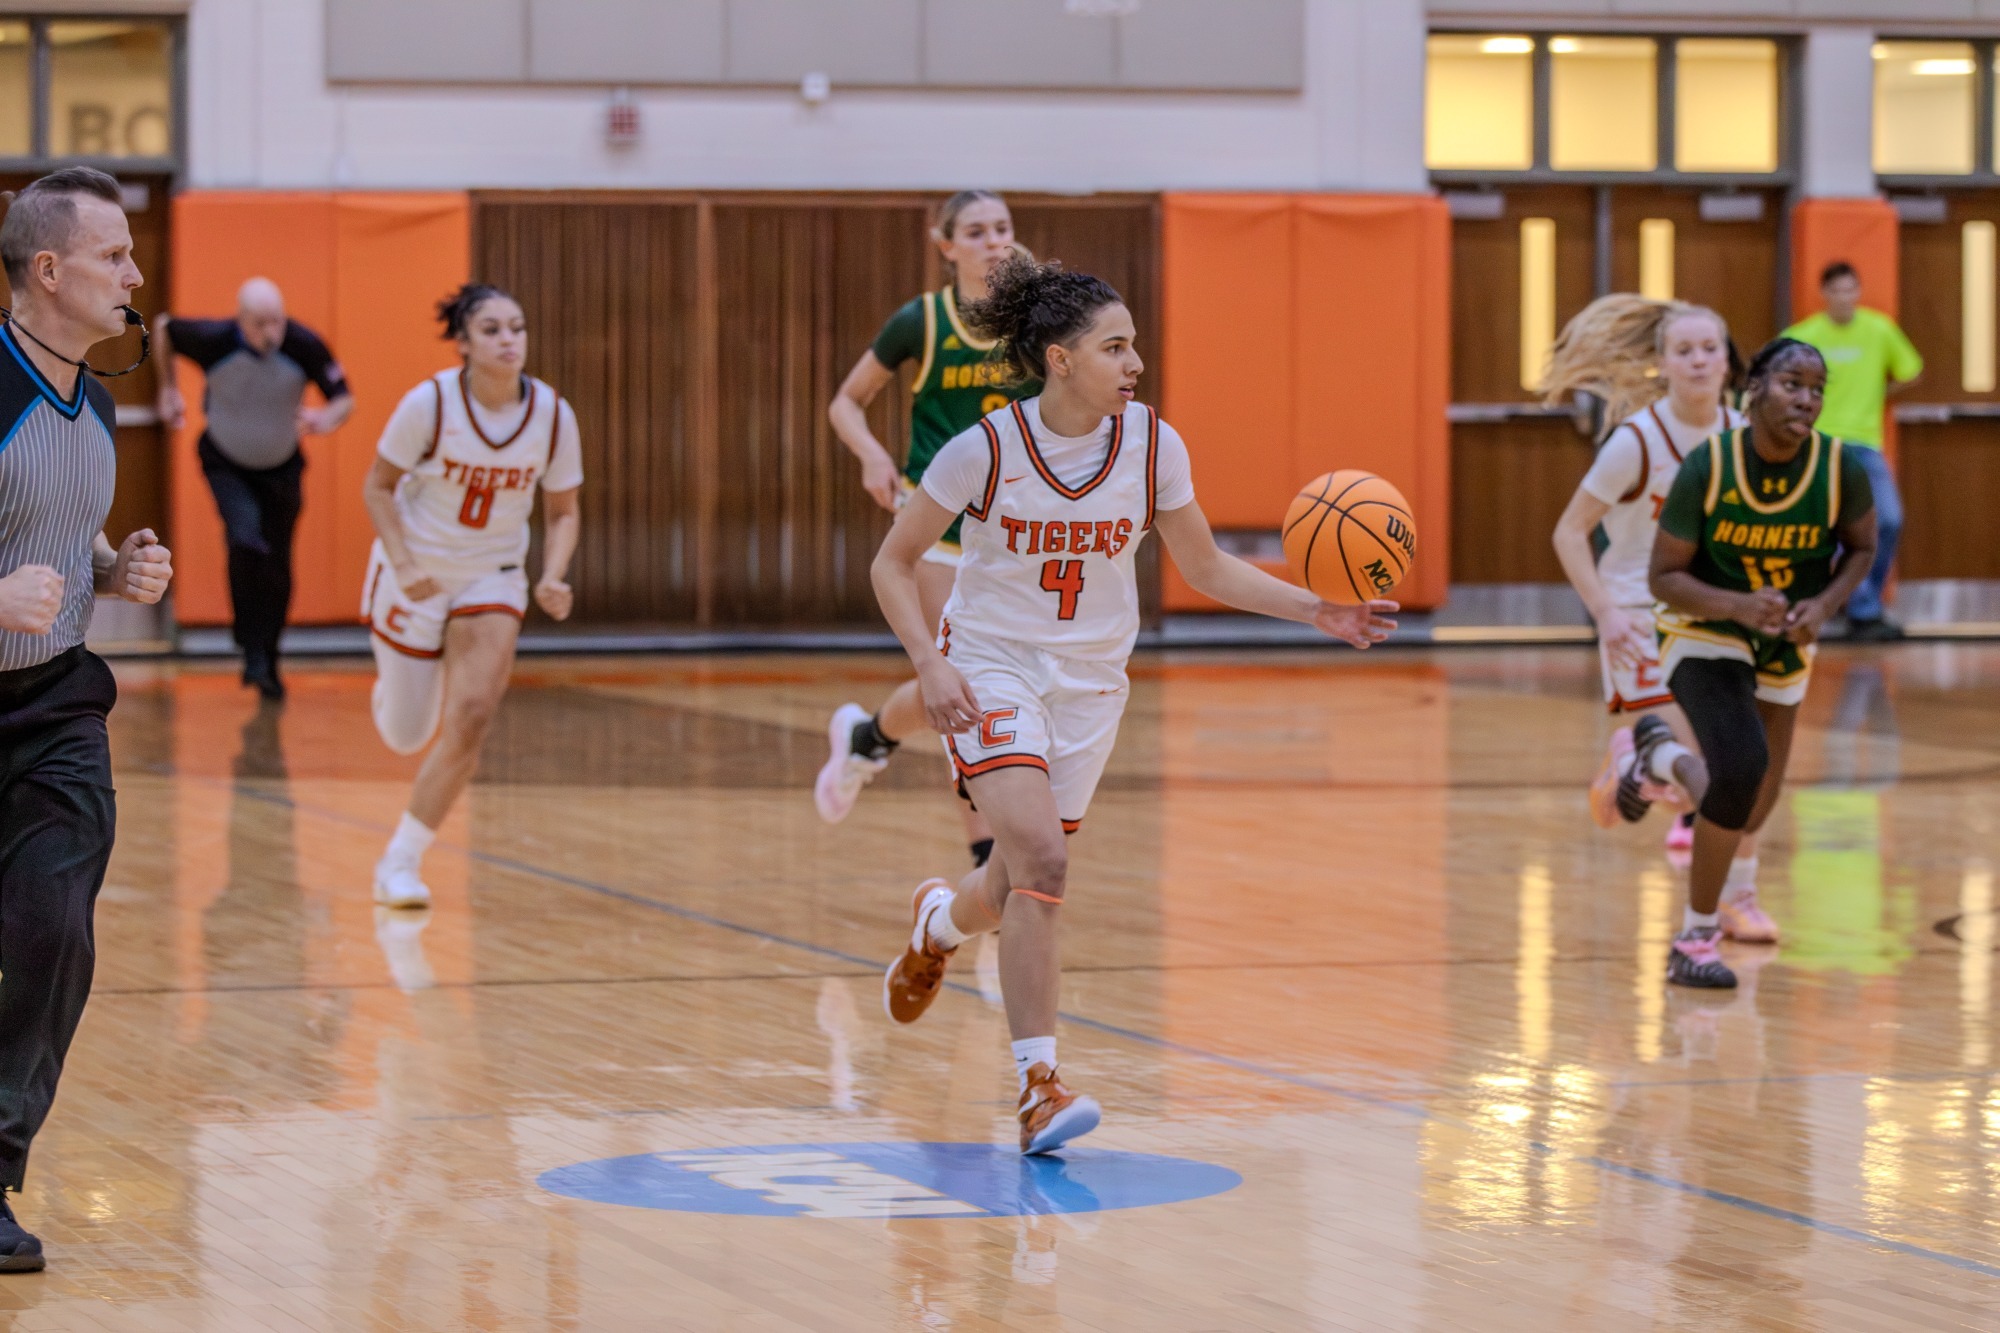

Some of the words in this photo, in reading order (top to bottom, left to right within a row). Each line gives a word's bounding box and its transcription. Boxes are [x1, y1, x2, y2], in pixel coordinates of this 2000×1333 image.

[443, 458, 535, 491] TIGERS
[1000, 515, 1133, 559] TIGERS
[1713, 519, 1820, 550] HORNETS
[1039, 559, 1085, 620] 4
[1741, 555, 1795, 592] 15
[978, 706, 1019, 749] C
[653, 1151, 989, 1218] NCAA
